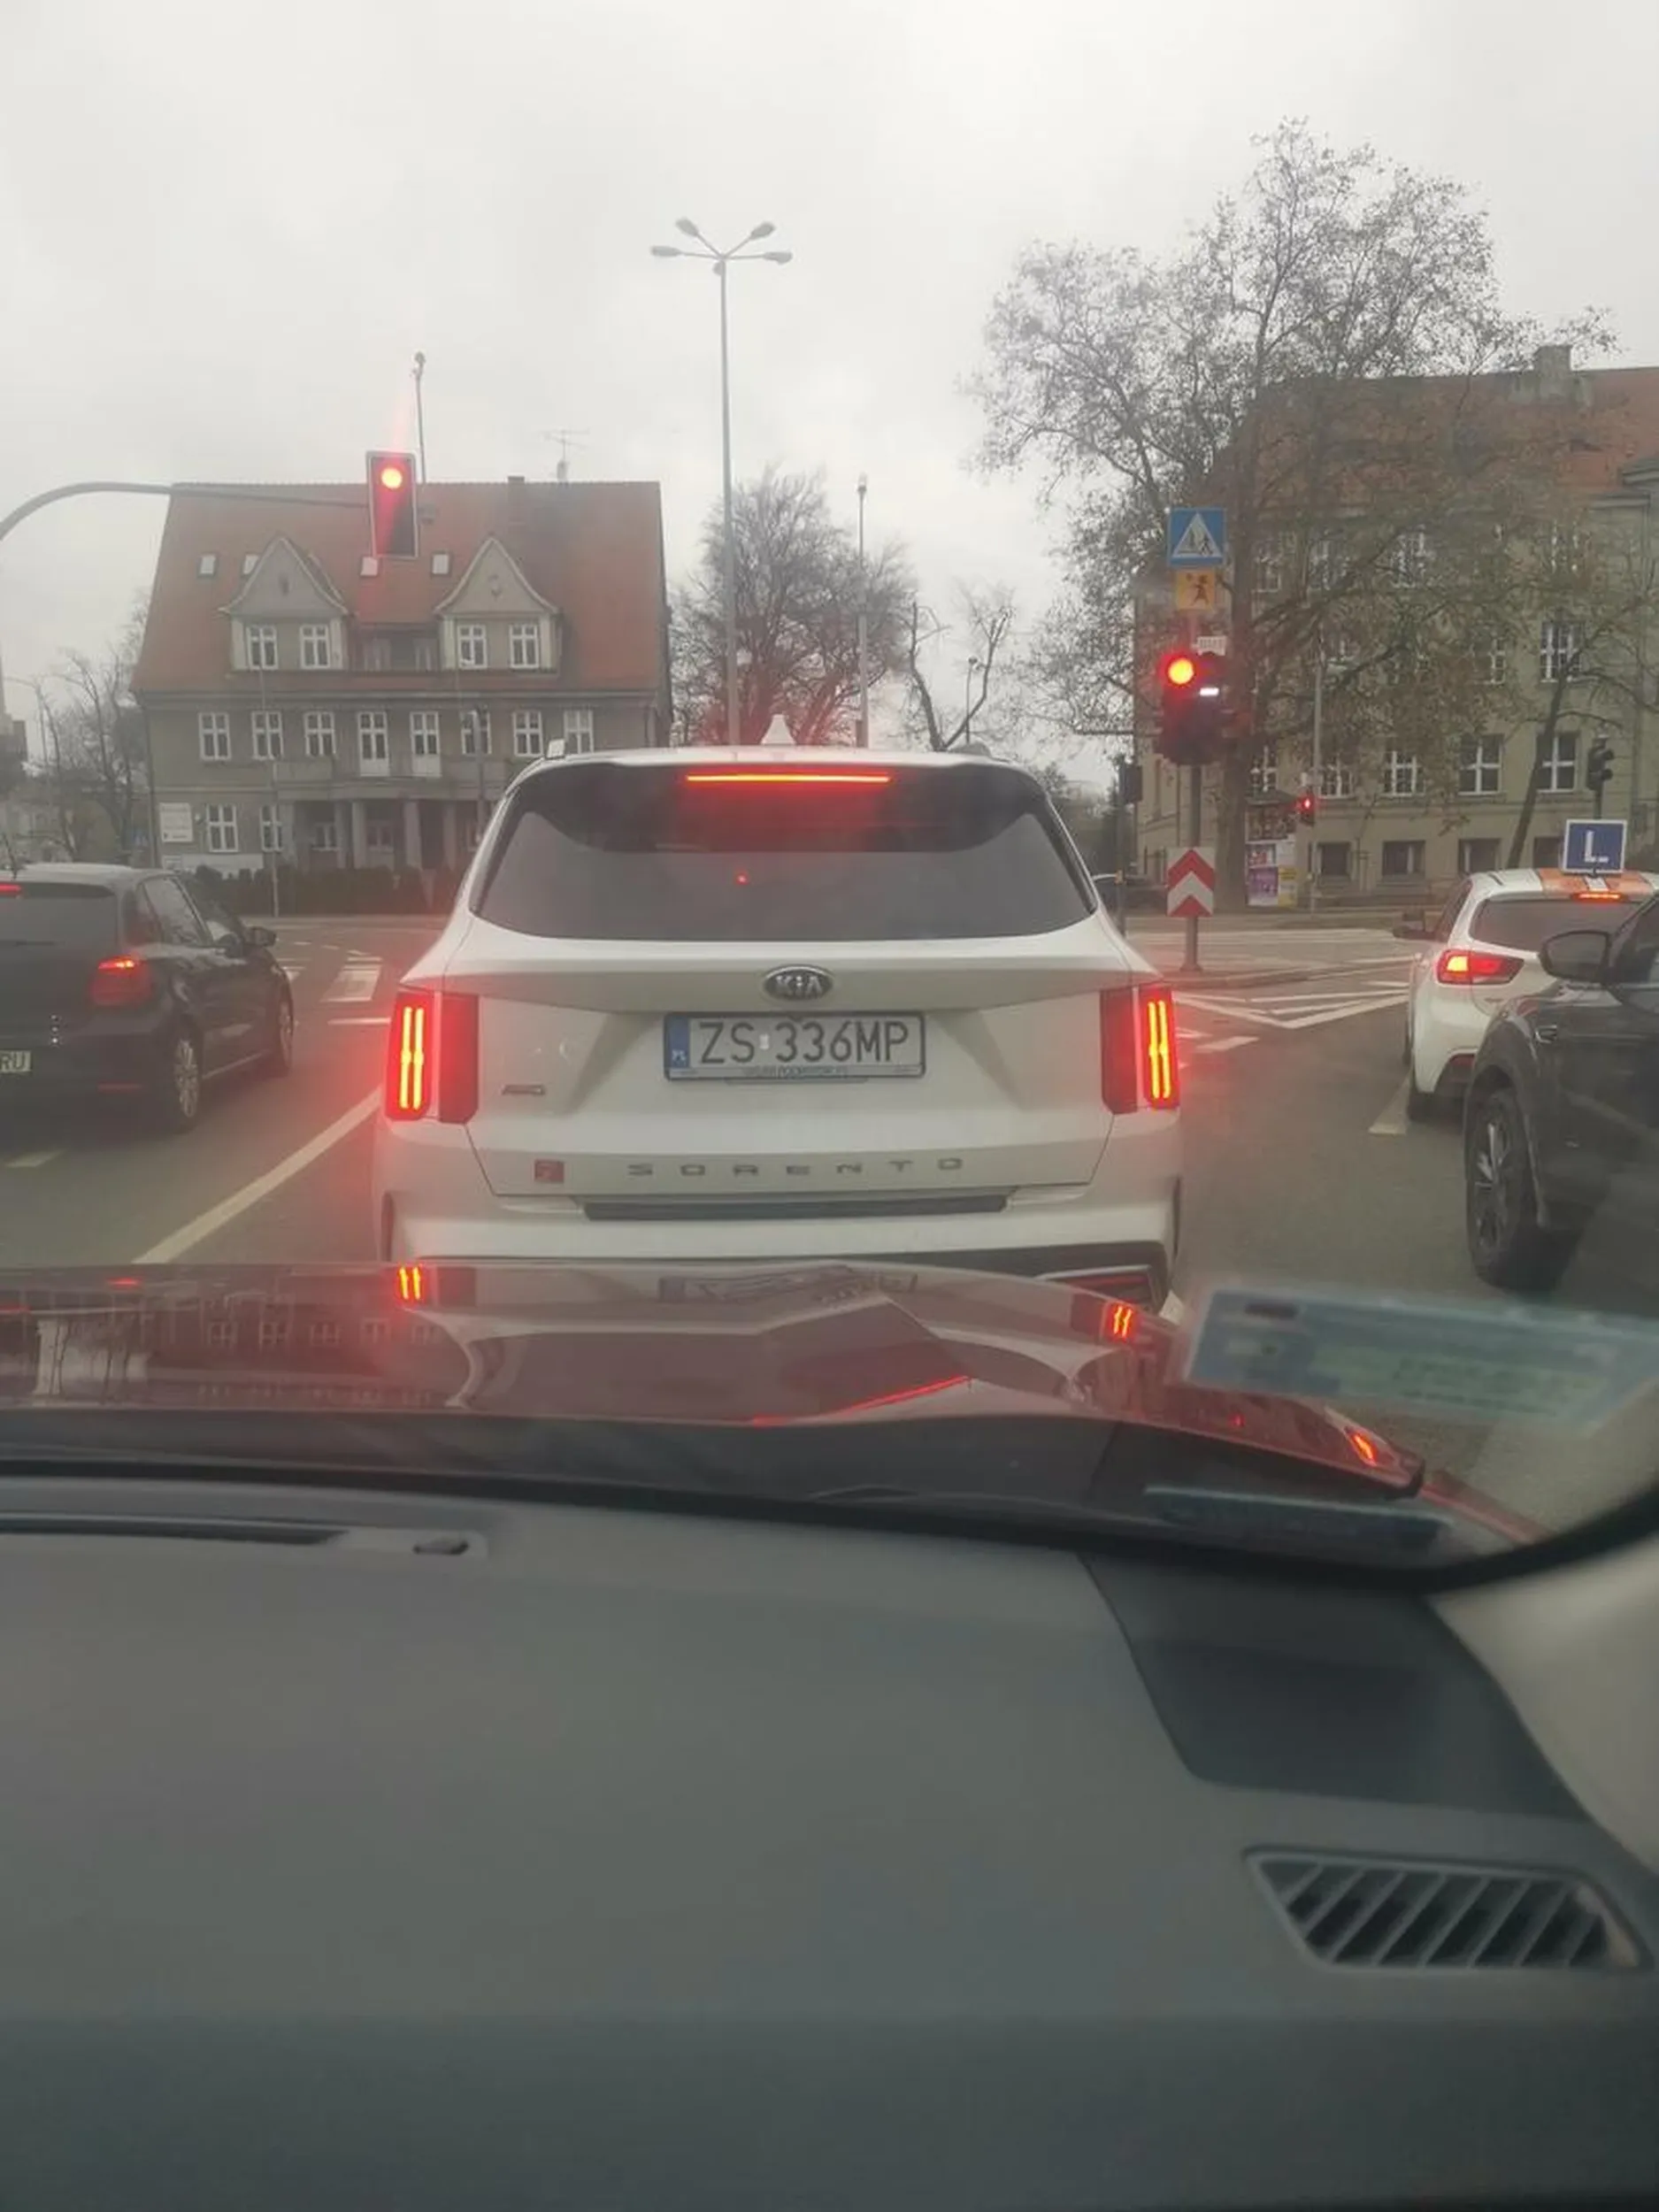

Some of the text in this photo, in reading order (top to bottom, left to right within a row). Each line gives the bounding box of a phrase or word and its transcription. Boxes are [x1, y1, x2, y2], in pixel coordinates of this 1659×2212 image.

[1585, 831, 1609, 862] L
[775, 975, 823, 996] KIA
[700, 1020, 910, 1064] ZS 336MP
[627, 1156, 964, 1178] SORENTO
